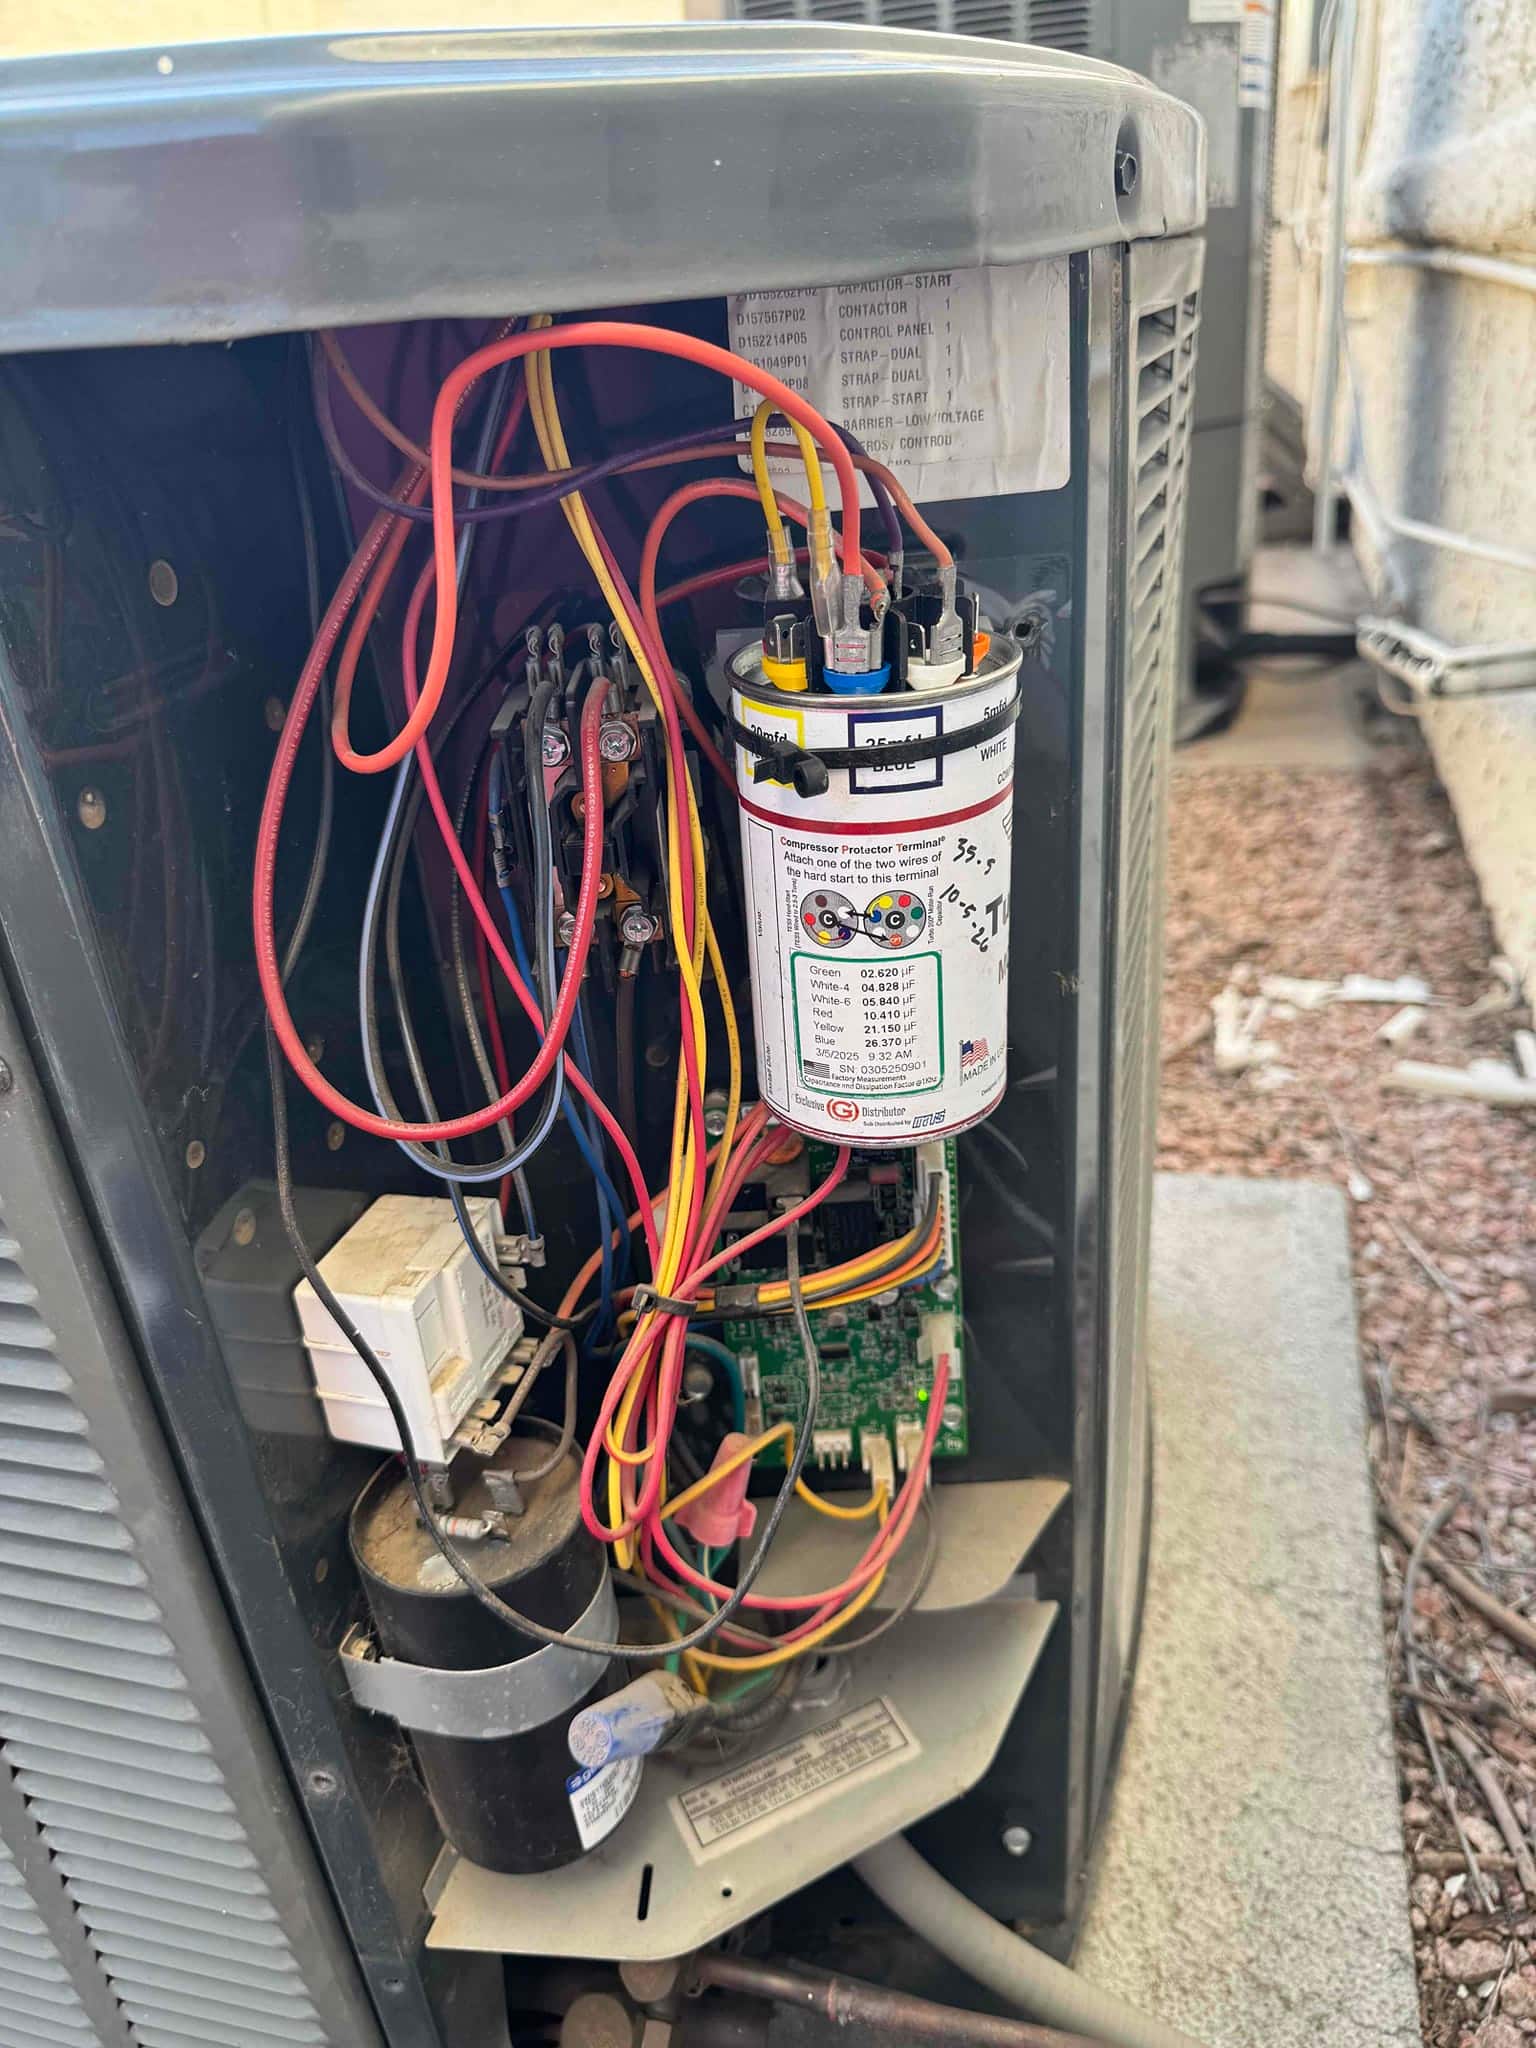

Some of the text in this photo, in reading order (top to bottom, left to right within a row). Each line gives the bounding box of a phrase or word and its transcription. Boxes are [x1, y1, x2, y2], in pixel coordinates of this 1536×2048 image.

[839, 301, 907, 318] CONTACTOR
[944, 297, 950, 310] 1
[738, 321, 950, 349] D152214P05 CONTROL PANEL 1
[945, 344, 951, 357] 1
[946, 389, 952, 401] 1
[980, 737, 1008, 762] WHITE
[780, 836, 839, 854] Compressor
[841, 844, 893, 855] Protector
[784, 851, 943, 870] Attach one of the two wires of
[786, 866, 939, 884] the hard start to this terminal
[823, 914, 833, 925] C
[891, 914, 900, 925] C
[809, 965, 841, 977] Green
[860, 968, 899, 978] 02.620
[810, 980, 850, 992] White-4
[861, 982, 899, 993] 04.828
[811, 993, 851, 1007] White-6
[862, 996, 900, 1007] 05.840
[812, 1007, 833, 1018] Red
[863, 1010, 901, 1021] 10.410
[813, 1021, 845, 1033] Yellow
[864, 1023, 901, 1034] 21.150
[815, 1034, 836, 1046] Blue
[865, 1037, 902, 1048] 26.370
[815, 1047, 859, 1061] 3/5/2025
[894, 1050, 913, 1060] AM
[861, 1060, 926, 1075] 0305250901
[963, 1060, 989, 1082] MADE
[804, 1075, 841, 1089] Capacitance
[855, 1081, 893, 1091] Dissipation
[894, 1080, 915, 1089] Factor
[831, 1073, 907, 1083] Factory Measurements
[795, 1094, 825, 1111] Exclusive
[862, 1106, 907, 1118] Distributor
